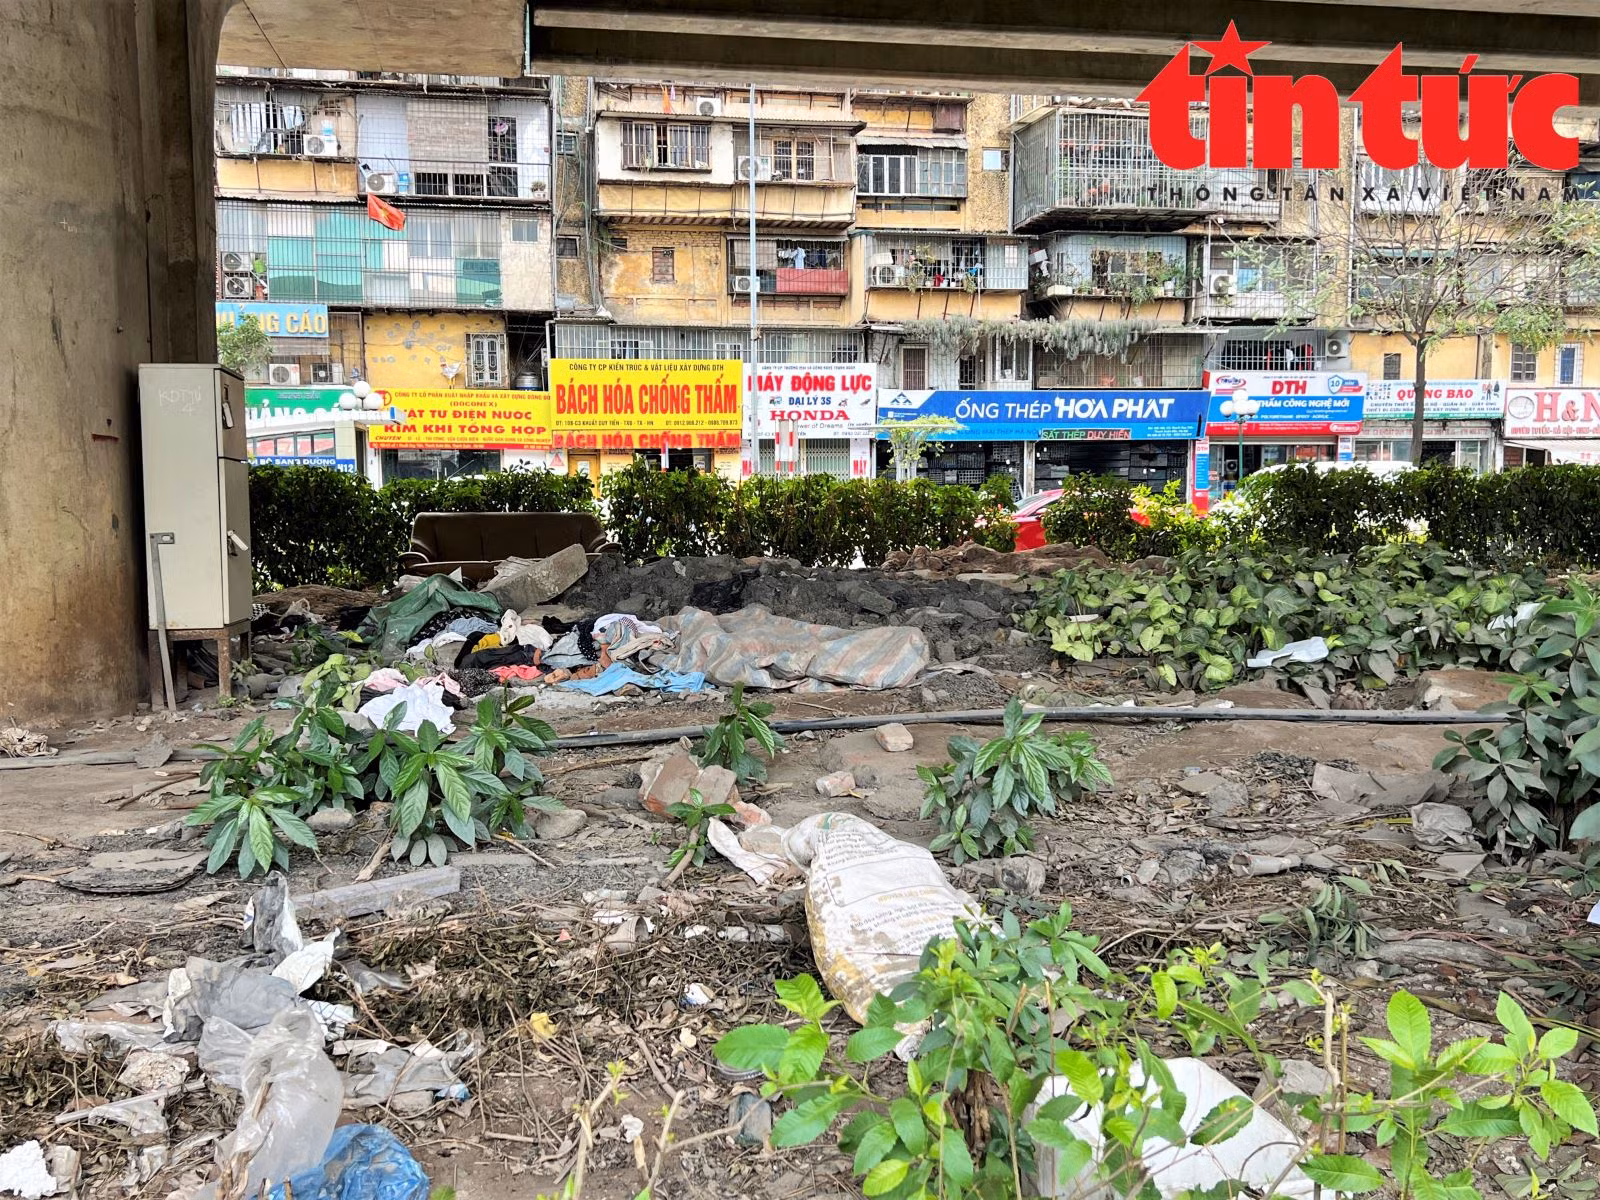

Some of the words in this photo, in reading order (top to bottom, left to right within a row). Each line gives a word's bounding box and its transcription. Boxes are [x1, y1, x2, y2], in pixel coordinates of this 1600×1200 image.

[286, 309, 327, 334] CÁO
[570, 362, 587, 371] CÔNG
[589, 363, 597, 371] TY
[598, 363, 607, 371] CP
[609, 361, 624, 371] KIẾN
[626, 362, 642, 371] TRÚC
[651, 363, 662, 372] VẬT
[664, 363, 678, 372] LIỆU
[680, 363, 691, 371] XÂY
[693, 363, 710, 372] DỰNG
[748, 371, 784, 391] MÁY
[791, 371, 835, 395] ĐỘNG
[841, 373, 872, 394] LỰC
[1271, 380, 1307, 395] DTH
[556, 377, 598, 414] BÁCH
[603, 377, 634, 414] HÓA
[639, 373, 691, 414] CHỐNG
[695, 373, 737, 414] THẤM
[1397, 389, 1442, 400] QUNG
[820, 396, 832, 406] 3S
[1283, 398, 1307, 407] CÔNG
[1308, 398, 1332, 409] NGHỆ
[1333, 398, 1350, 407] MỚI
[404, 408, 425, 420] ẬT
[452, 409, 487, 421] ĐIỆN
[955, 398, 999, 419] ỐNG
[1005, 400, 1052, 419] THÉP
[1056, 398, 1109, 419] HÒA
[1111, 398, 1175, 419] PHÁT
[769, 410, 850, 420] HONDA
[384, 424, 417, 433] KIM
[459, 421, 505, 433] TỔNG
[554, 431, 597, 449] BÁCH
[601, 431, 634, 449] HÓA
[638, 430, 692, 449] CHỐNG
[697, 430, 741, 449] THẤM
[1061, 428, 1086, 439] THÉP
